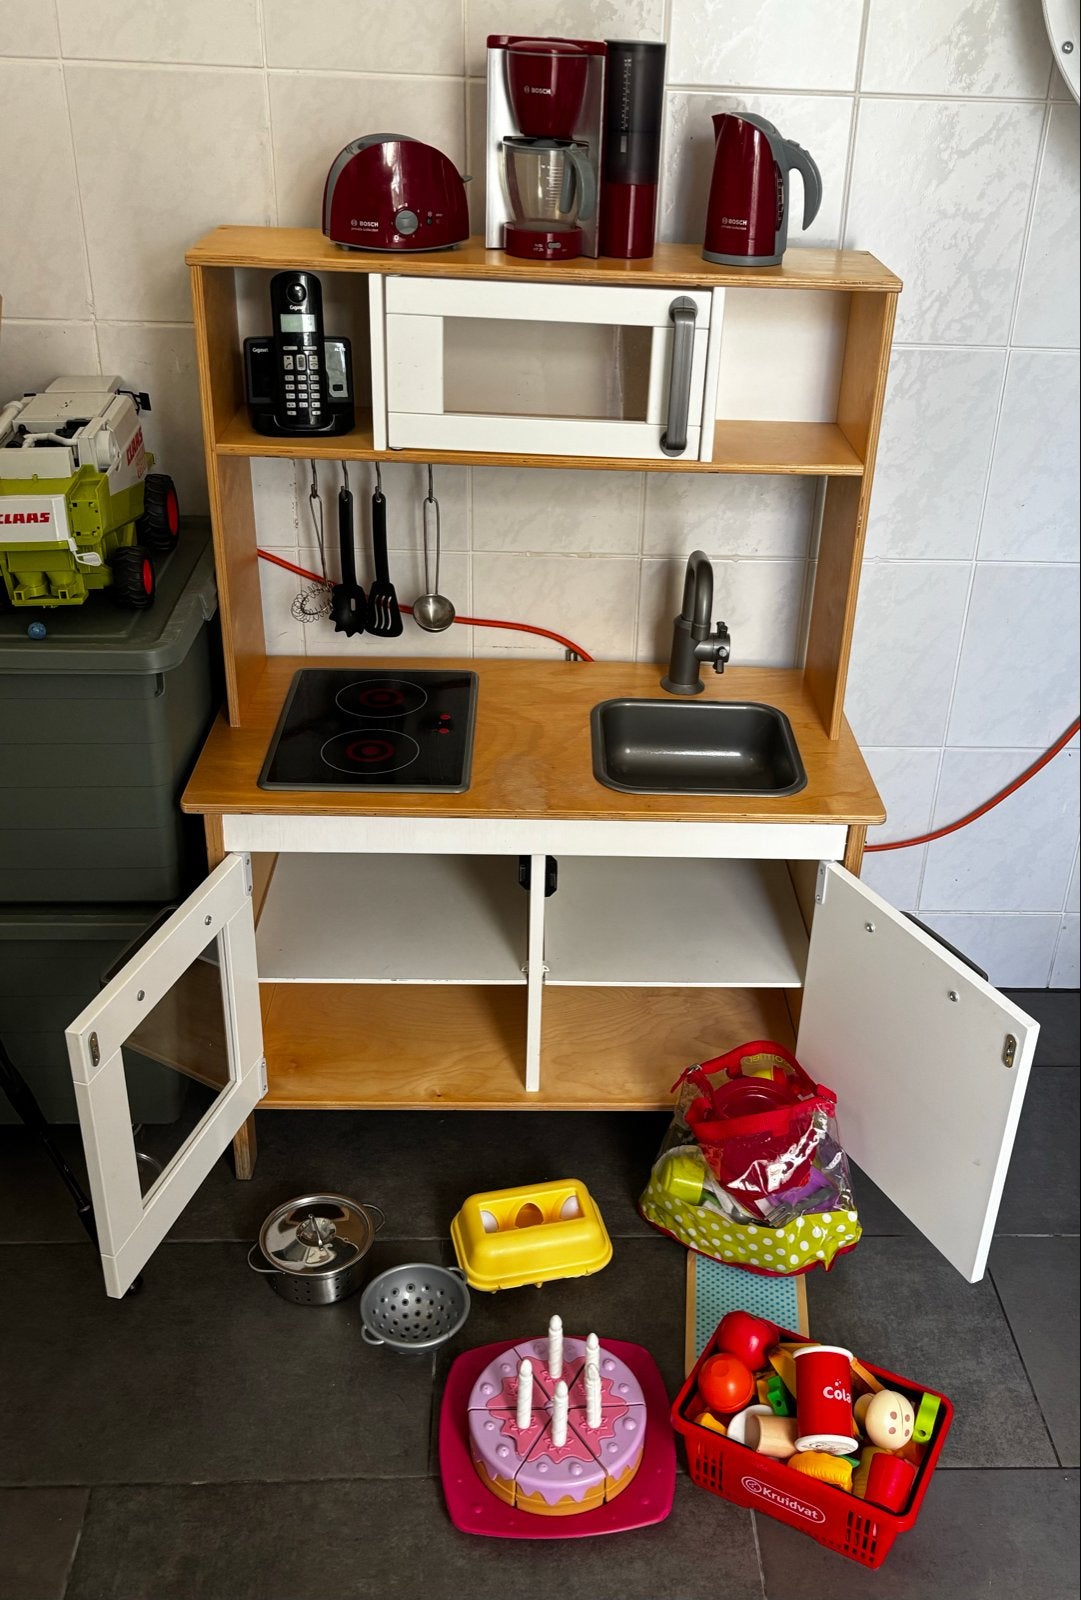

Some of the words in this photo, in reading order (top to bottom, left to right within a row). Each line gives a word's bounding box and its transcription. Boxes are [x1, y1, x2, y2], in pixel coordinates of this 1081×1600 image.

[728, 218, 748, 226] BOSCH
[822, 1386, 852, 1404] Cola
[762, 1486, 819, 1520] Kruidvat
